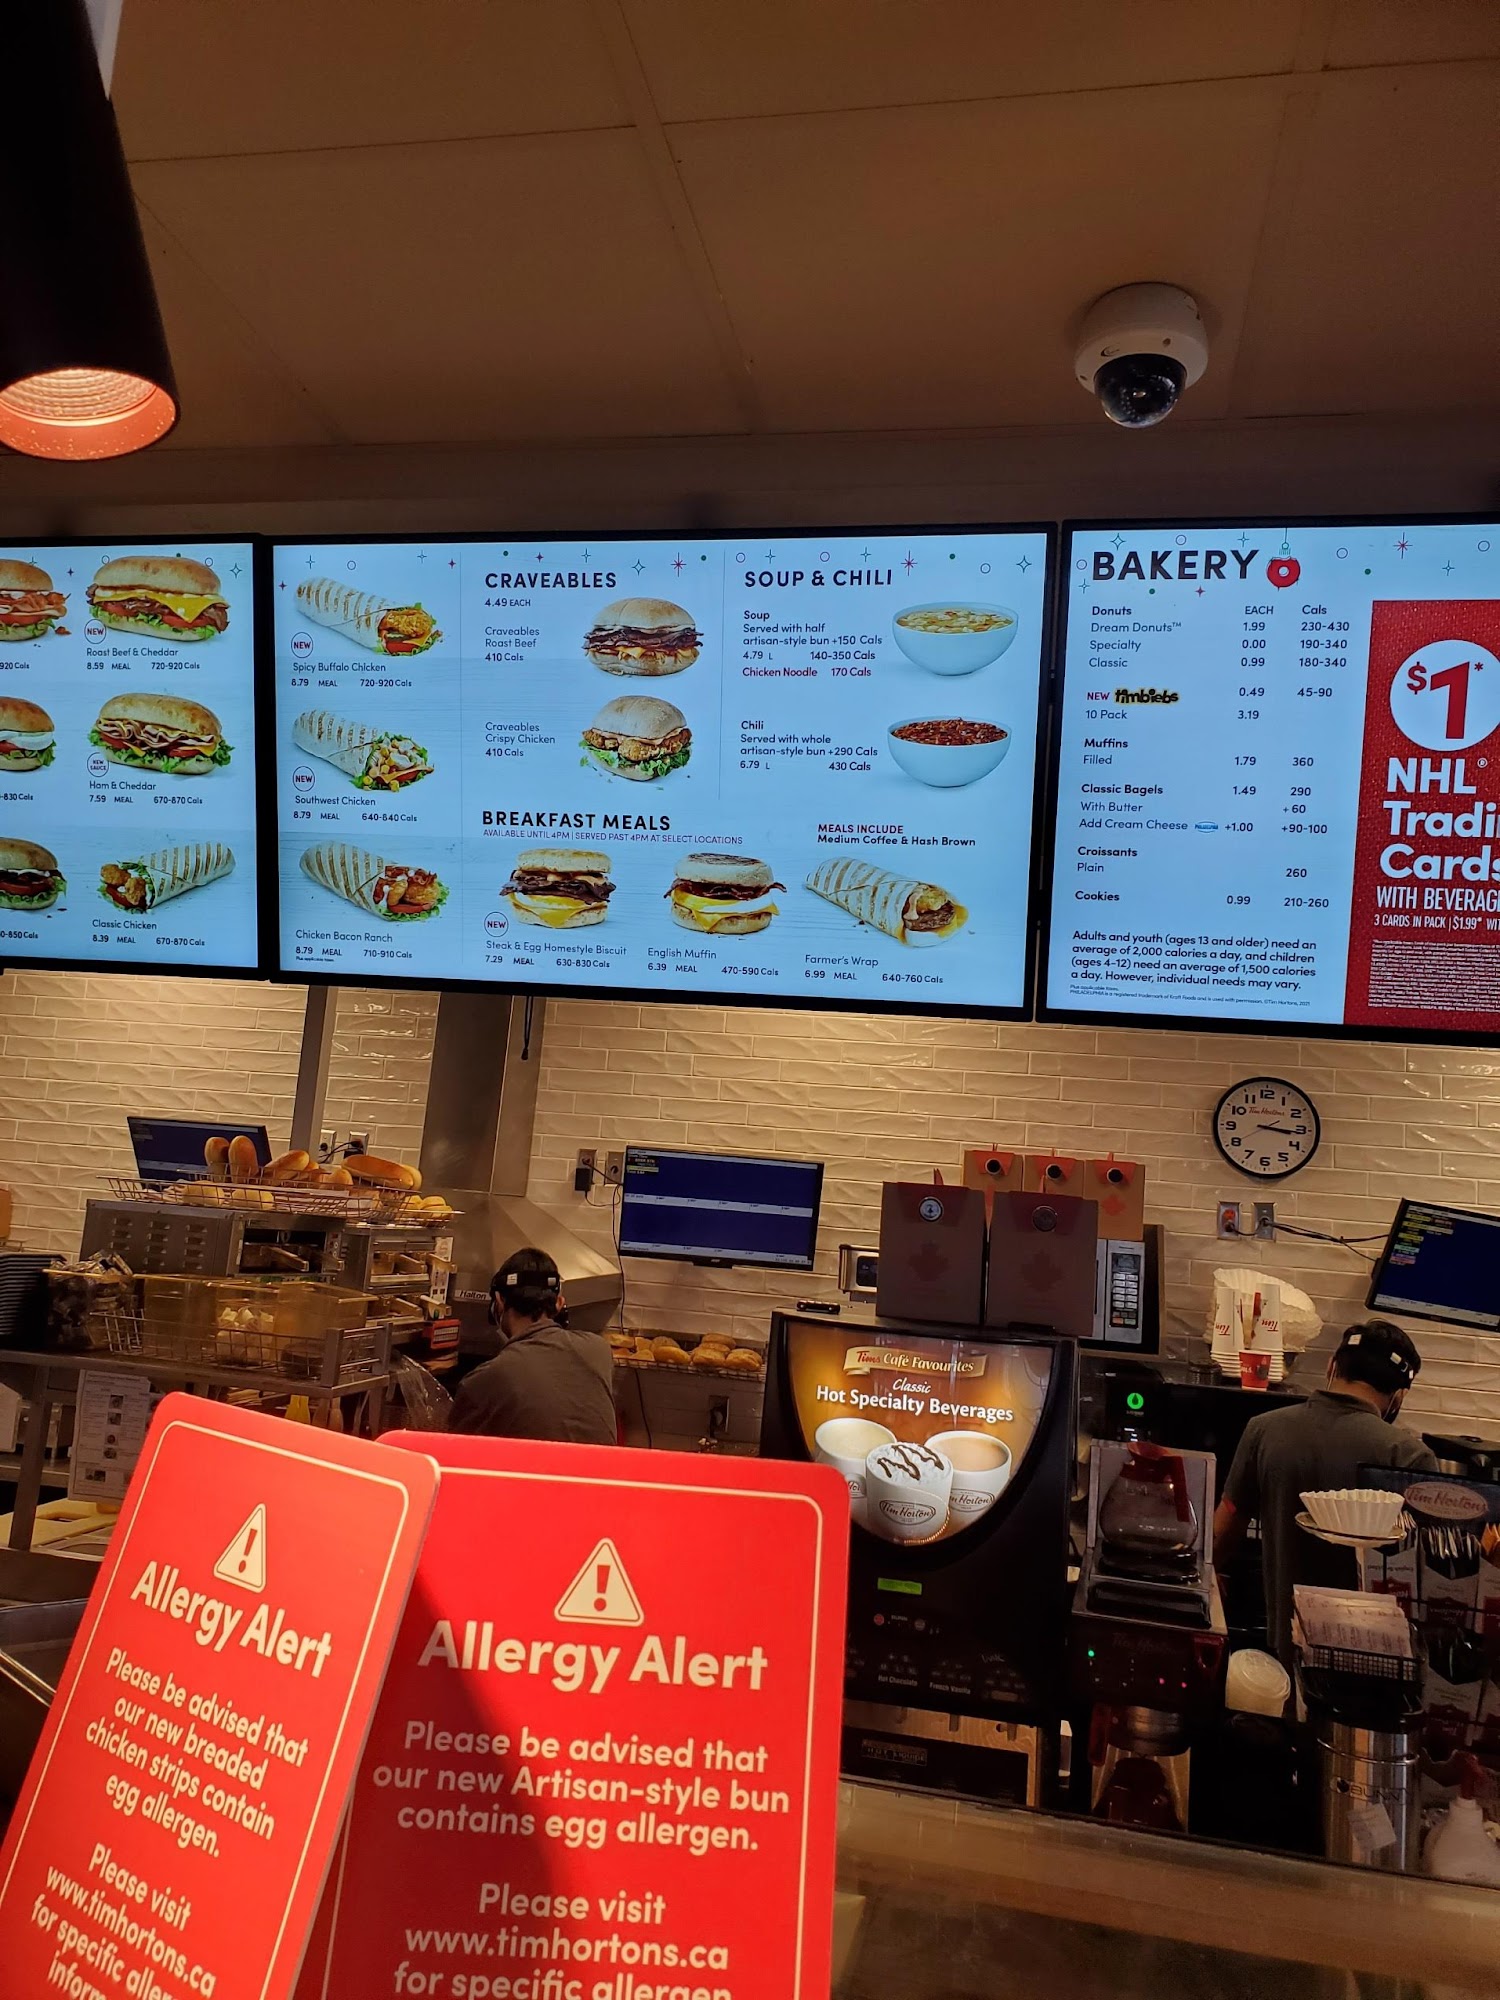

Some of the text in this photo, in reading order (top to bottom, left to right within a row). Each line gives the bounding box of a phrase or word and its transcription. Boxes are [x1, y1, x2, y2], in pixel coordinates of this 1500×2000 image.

[1092, 549, 1260, 581] BAKERY
[485, 572, 617, 589] CRAVEABLES
[744, 569, 892, 588] SOUP & CHILI
[484, 597, 531, 607] 4.49 EACH
[743, 610, 770, 622] Soup
[1092, 604, 1327, 616] Donuts EACH Cals
[86, 627, 105, 636] NEW
[484, 625, 540, 636] Craveables
[743, 622, 826, 633] Served with half
[1091, 622, 1130, 633] Dream
[1243, 621, 1266, 632] 1.99
[1301, 621, 1350, 632] 230-430
[293, 641, 312, 650] NEW
[485, 638, 537, 648] Roast Beef
[742, 634, 883, 648] artisan-style bun +150 Cals
[1089, 639, 1348, 653] Specialty 0.00 190-340
[86, 647, 179, 657] Roast Beef & Cheddar
[484, 652, 524, 662] 410 Cals
[742, 650, 876, 661] 4.79 L 140-350 Cals
[86, 661, 201, 670] 8.59 MEAL 720-920 Cals
[292, 662, 386, 674] Spicy Buffalo Chicken
[1088, 657, 1347, 668] Classic 0.99 180-340
[742, 666, 872, 677] Chicken Noodle 170 Cals
[318, 679, 338, 687] MEAL
[360, 678, 394, 687] 720-920
[394, 679, 412, 687] Cals
[1086, 691, 1110, 701] NEW
[1239, 687, 1265, 697] 0.49
[1297, 687, 1333, 698] 45-90
[485, 721, 540, 732] Craveables
[741, 720, 764, 730] Chili
[485, 733, 556, 746] Crispy Chicken
[740, 733, 832, 744] Served with whole
[1084, 738, 1129, 748] Muffins
[485, 748, 524, 757] 410 Cals
[89, 780, 157, 791] Ham & Cheddar
[482, 810, 670, 831] BREAKFAST MEALS
[1382, 800, 1500, 839] Tradi
[817, 823, 904, 834] MEALS INCLUDE
[817, 834, 976, 846] Medium Coffee & Hash Brown
[1074, 890, 1329, 908] Cookies 0.99 210-260
[1376, 885, 1500, 913] WITH BEVERAG
[91, 919, 157, 930] Classic Chicken
[487, 920, 507, 929] NEW
[295, 929, 393, 943] Chicken Bacon Ranch
[486, 940, 627, 956] Steak & Egg Homestyle Biscuit
[805, 954, 879, 969] Farmer's Wrap
[1259, 1089, 1275, 1100] 12
[1231, 1105, 1247, 1116] 10
[1225, 1120, 1237, 1131] 9
[1259, 1156, 1271, 1167] 6
[459, 1290, 487, 1300] Halton
[855, 1350, 975, 1373] Tims Café Favourites
[892, 1377, 932, 1394] Classic
[816, 1385, 1014, 1424] Hot Specialty Beverages
[129, 1559, 333, 1680] Allergy Alert
[417, 1618, 770, 1695] Allergy Alert
[103, 1646, 310, 1769] Please be advised that
[113, 1696, 269, 1791] our new breaded
[403, 1720, 770, 1774] Please be advised that
[84, 1717, 277, 1841] chicken strips contain
[372, 1764, 791, 1815] our new Artisan-style bun
[104, 1774, 222, 1859] egg allergen.
[396, 1804, 760, 1857] contains egg allergen.
[86, 1842, 193, 1932] Please visit
[478, 1882, 667, 1926] Please visit
[44, 1863, 218, 1998] www.timhortons.ca
[404, 1927, 731, 1972] www.timhortons.ca
